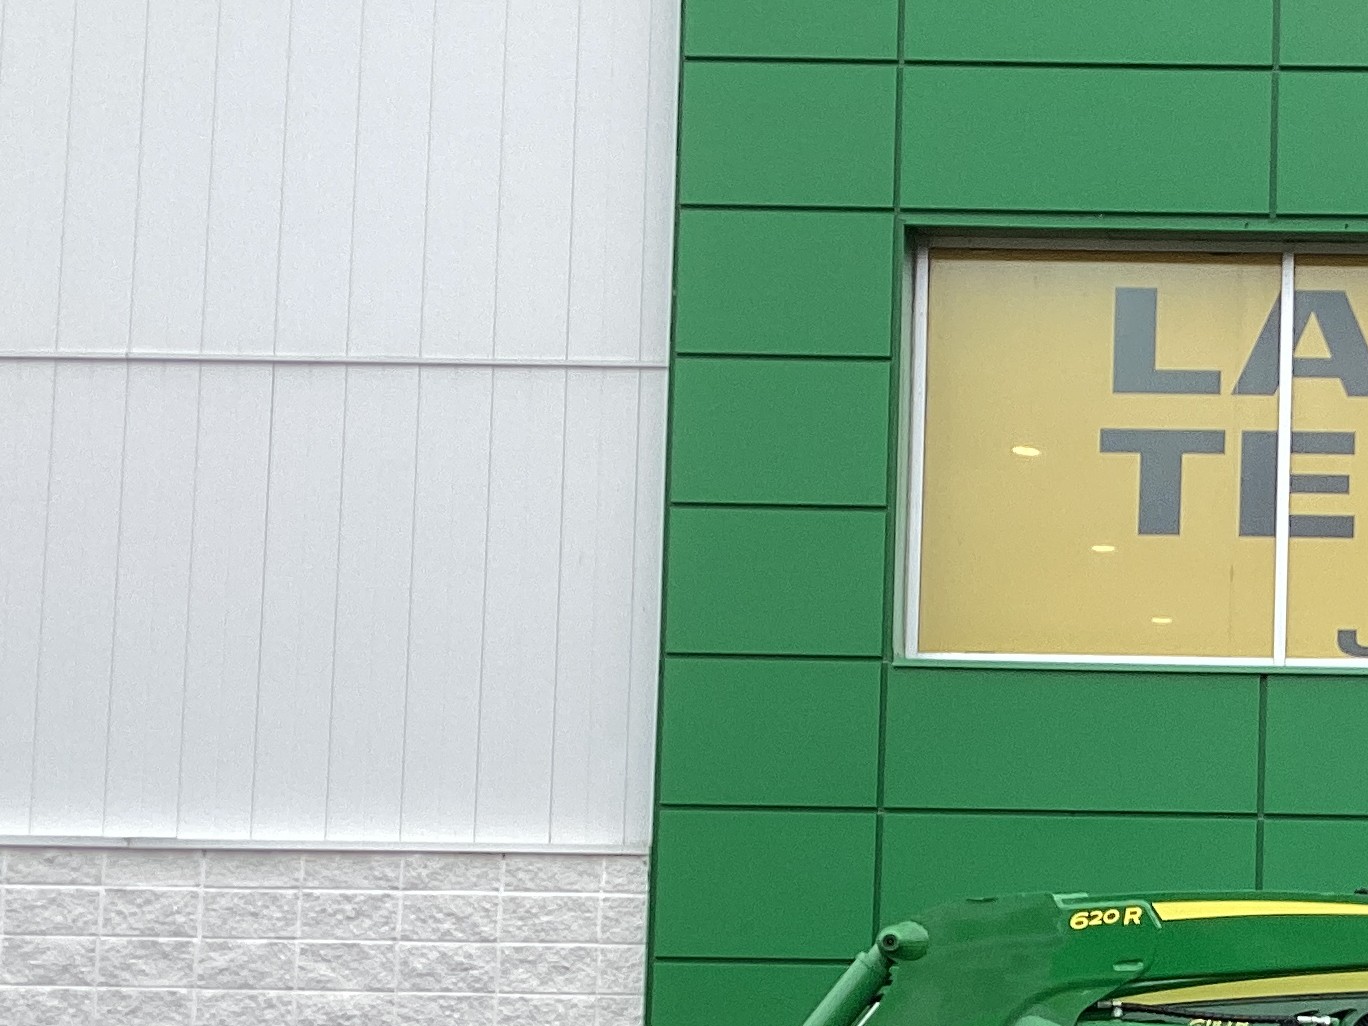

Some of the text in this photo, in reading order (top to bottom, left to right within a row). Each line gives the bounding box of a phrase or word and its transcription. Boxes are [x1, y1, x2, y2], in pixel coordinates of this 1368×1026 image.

[1098, 428, 1356, 539] TE
[1069, 906, 1143, 930] 620 R
